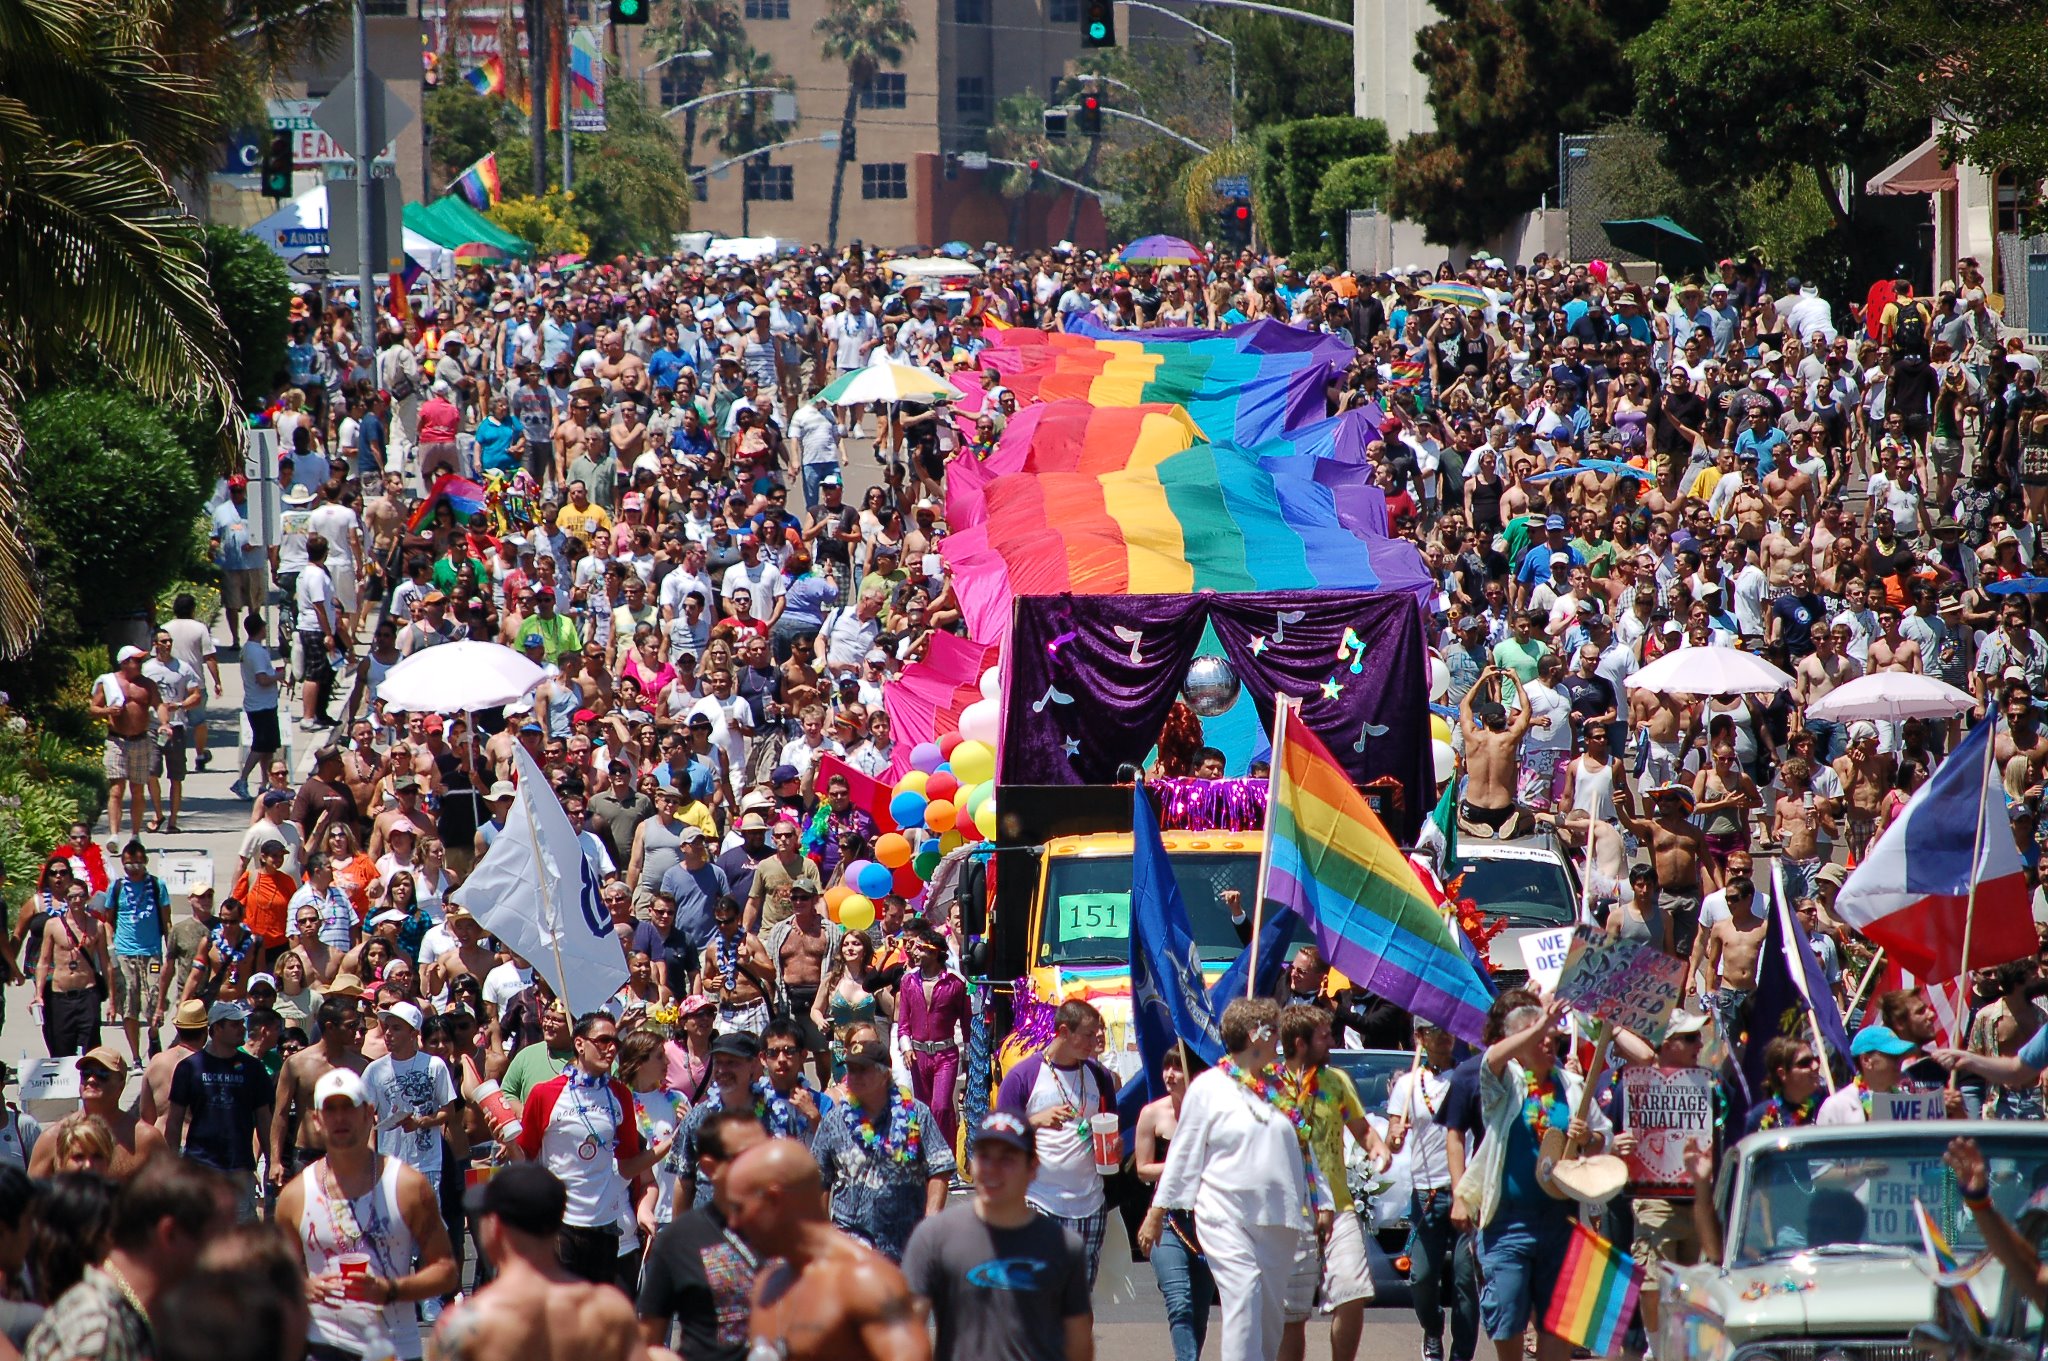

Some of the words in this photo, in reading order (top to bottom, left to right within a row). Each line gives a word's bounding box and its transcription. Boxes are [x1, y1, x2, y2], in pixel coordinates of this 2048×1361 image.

[1070, 904, 1118, 928] 151
[1537, 934, 1565, 951] WE
[1628, 1094, 1708, 1112] MARRIAGE
[1891, 1100, 1922, 1121] WE
[1628, 1110, 1708, 1130] EQUALITY
[1871, 1208, 1898, 1234] TO
